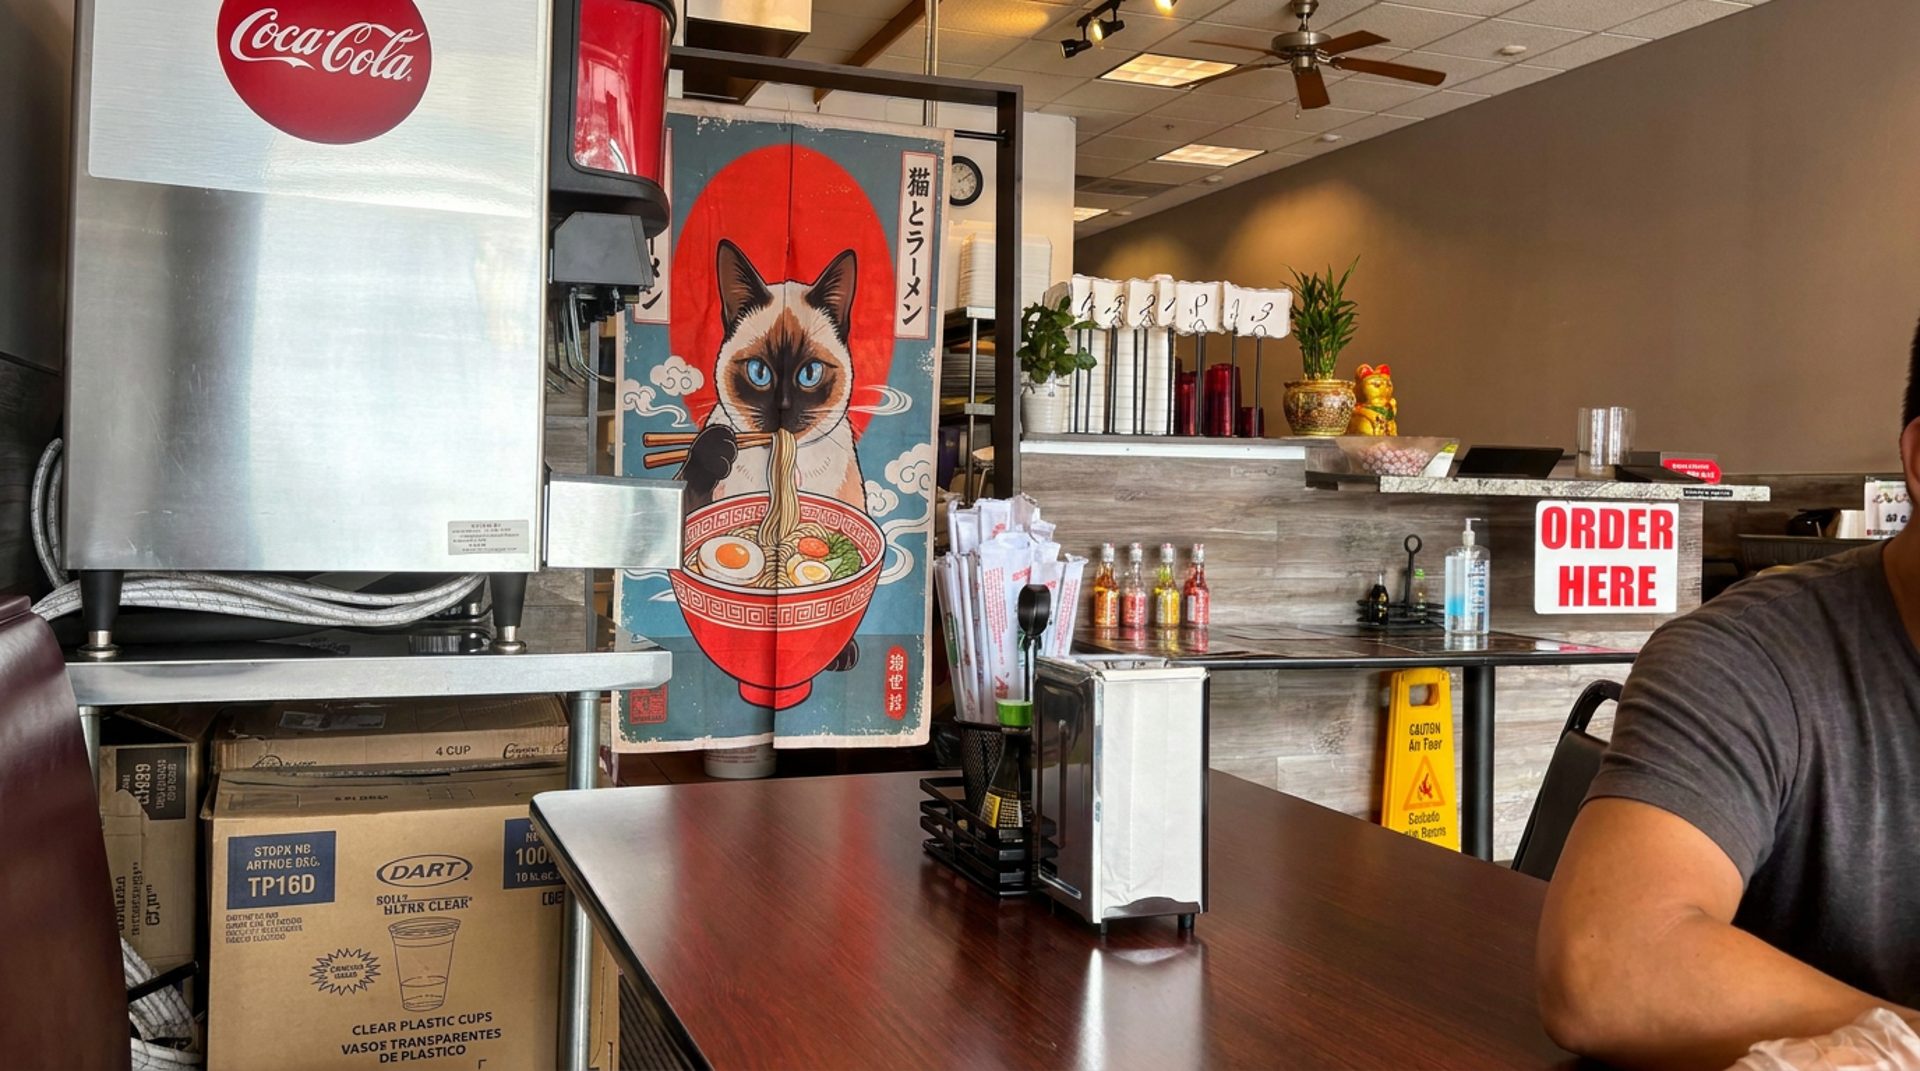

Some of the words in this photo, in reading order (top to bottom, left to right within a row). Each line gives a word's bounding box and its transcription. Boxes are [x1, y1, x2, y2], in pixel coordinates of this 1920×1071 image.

[230, 8, 425, 82] Coca-Cola
[902, 167, 930, 326] 猫とラーメン
[1541, 506, 1674, 550] ORDER
[1558, 566, 1657, 607] HERE
[446, 745, 471, 756] CUP
[389, 861, 462, 881] DART
[247, 873, 316, 898] TP16D
[352, 1021, 396, 1036] CLEAR
[400, 1015, 455, 1031] PLASTIC
[458, 1011, 493, 1025] CUPS
[390, 1028, 502, 1051] TRANSPARENTES
[379, 1052, 398, 1063] DE
[401, 1044, 466, 1061] PLASTICO
